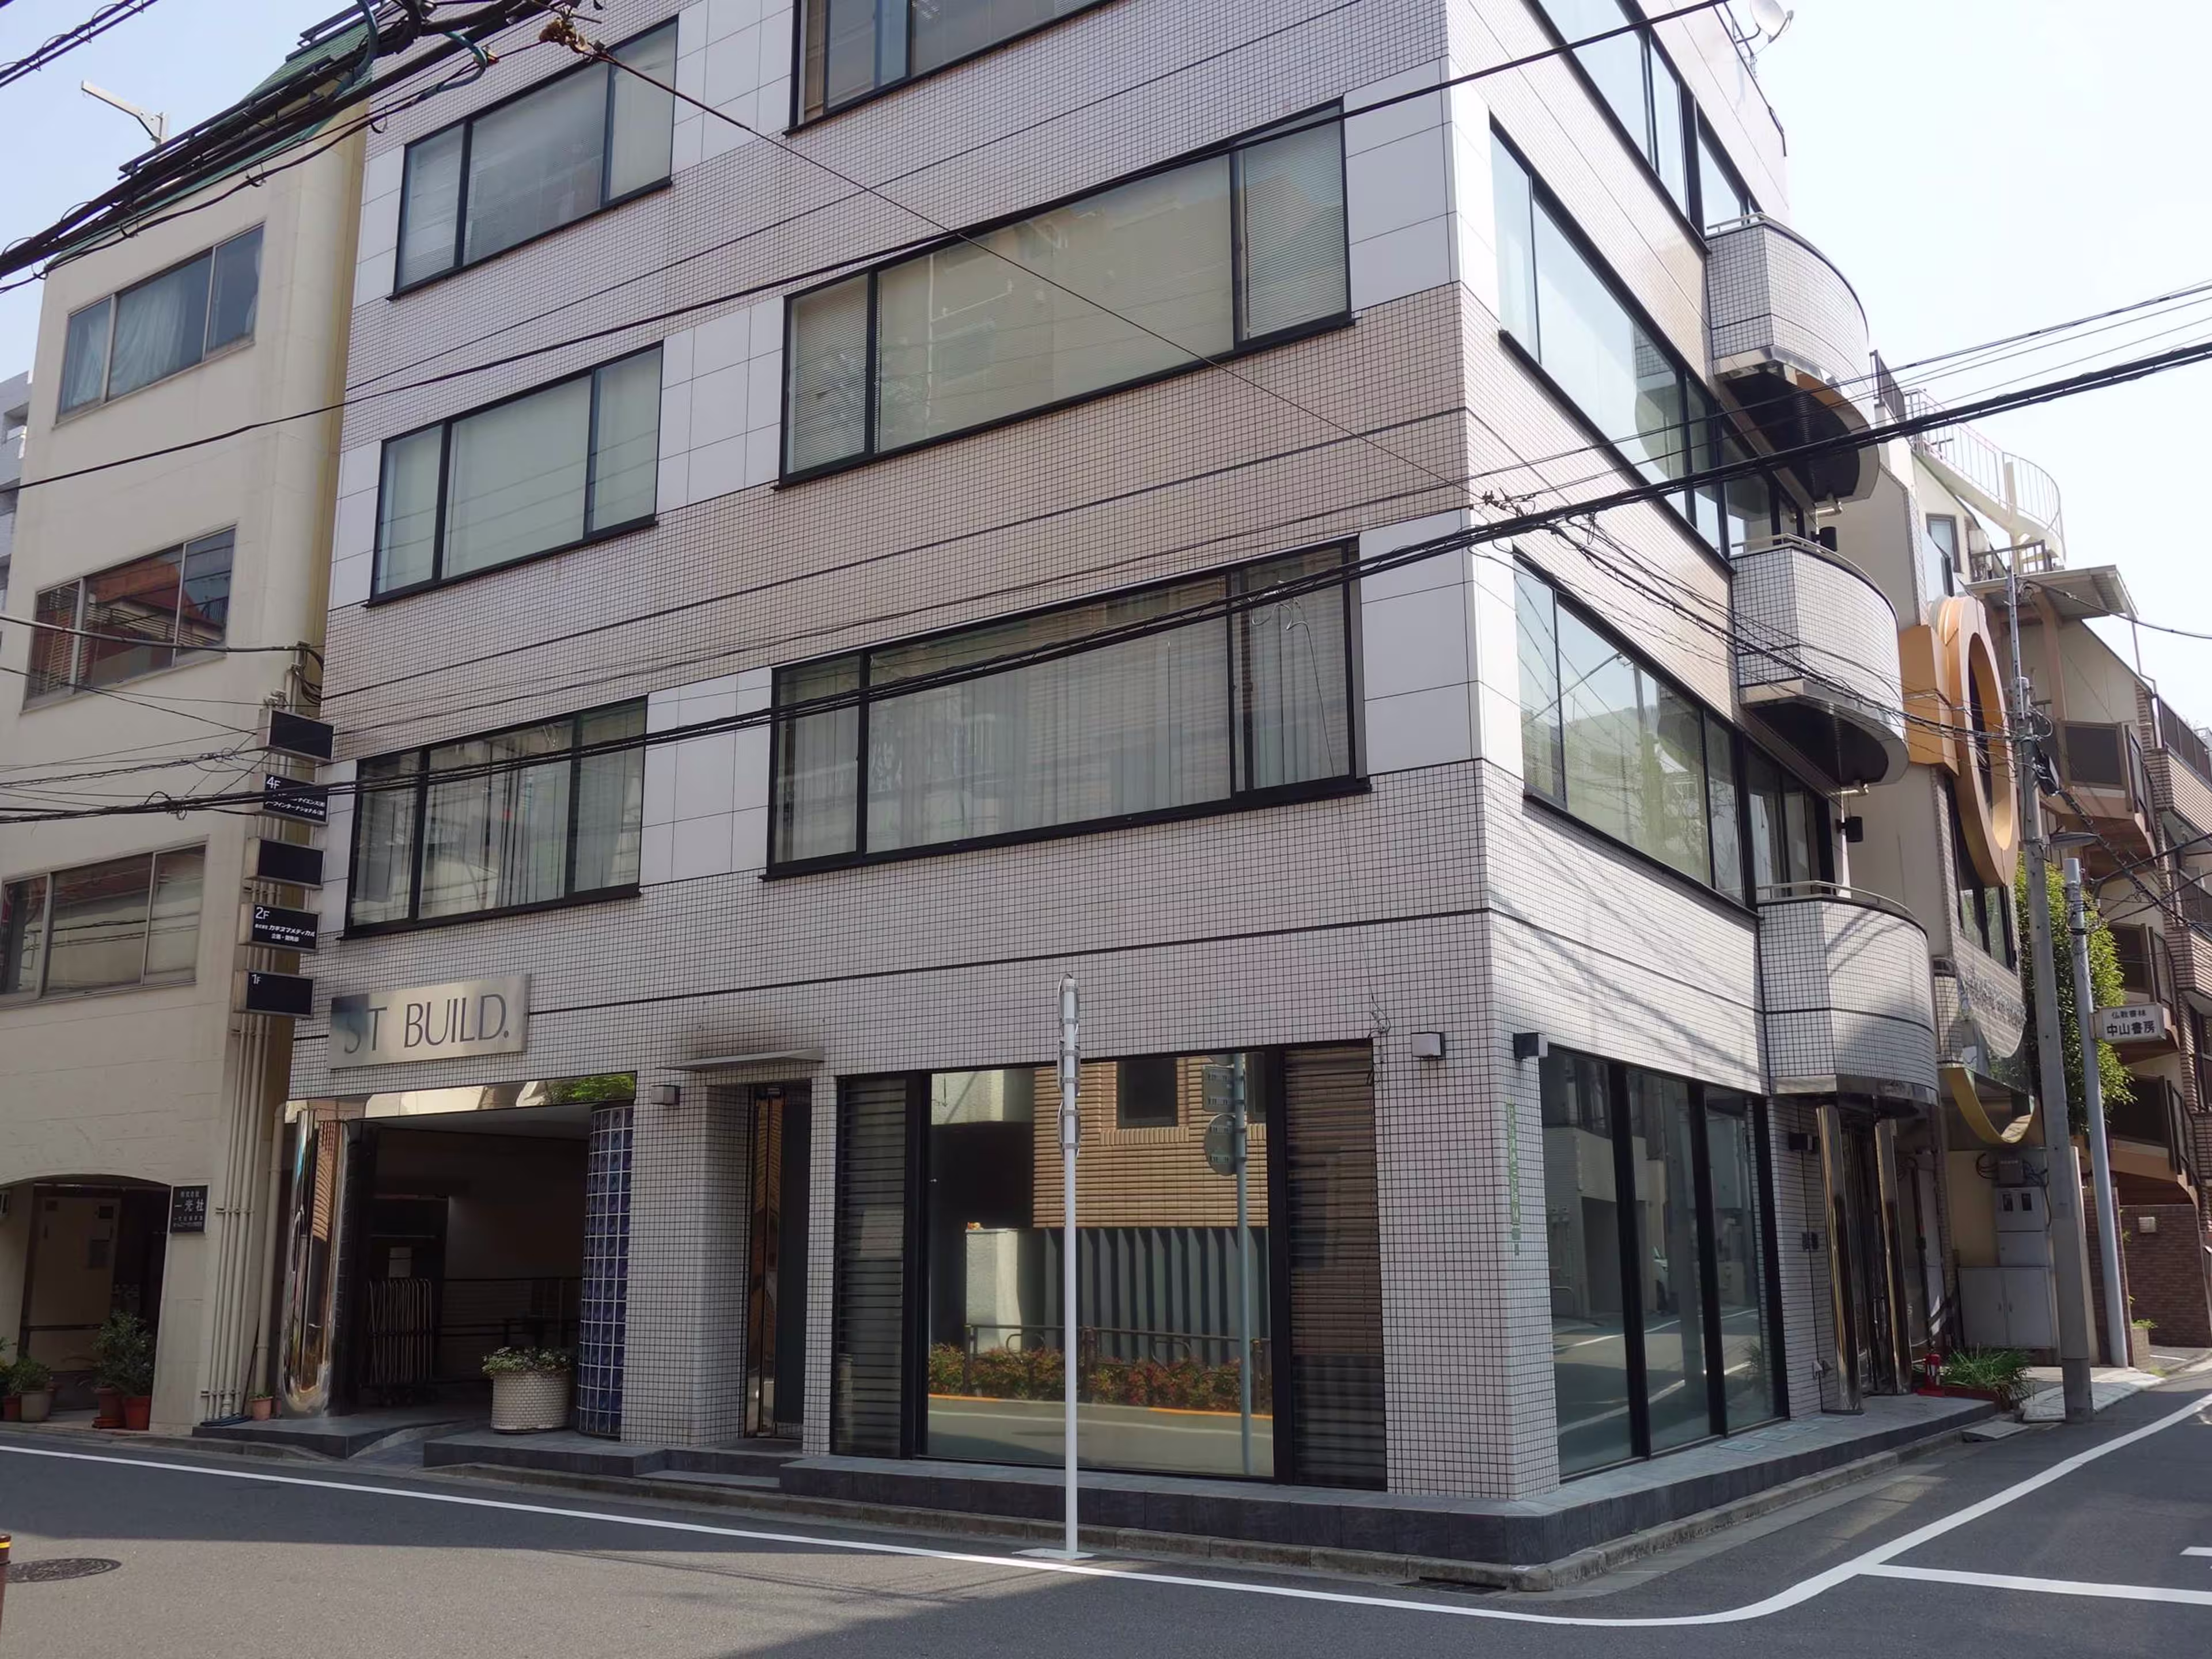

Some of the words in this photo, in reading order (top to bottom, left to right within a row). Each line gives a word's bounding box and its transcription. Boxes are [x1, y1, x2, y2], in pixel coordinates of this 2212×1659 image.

[267, 777, 281, 789] 4F
[255, 907, 270, 920] 2F
[252, 974, 261, 984] 1F
[344, 1005, 388, 1054] ST
[404, 994, 509, 1048] BUILD.
[2106, 1020, 2156, 1037] 中山書房
